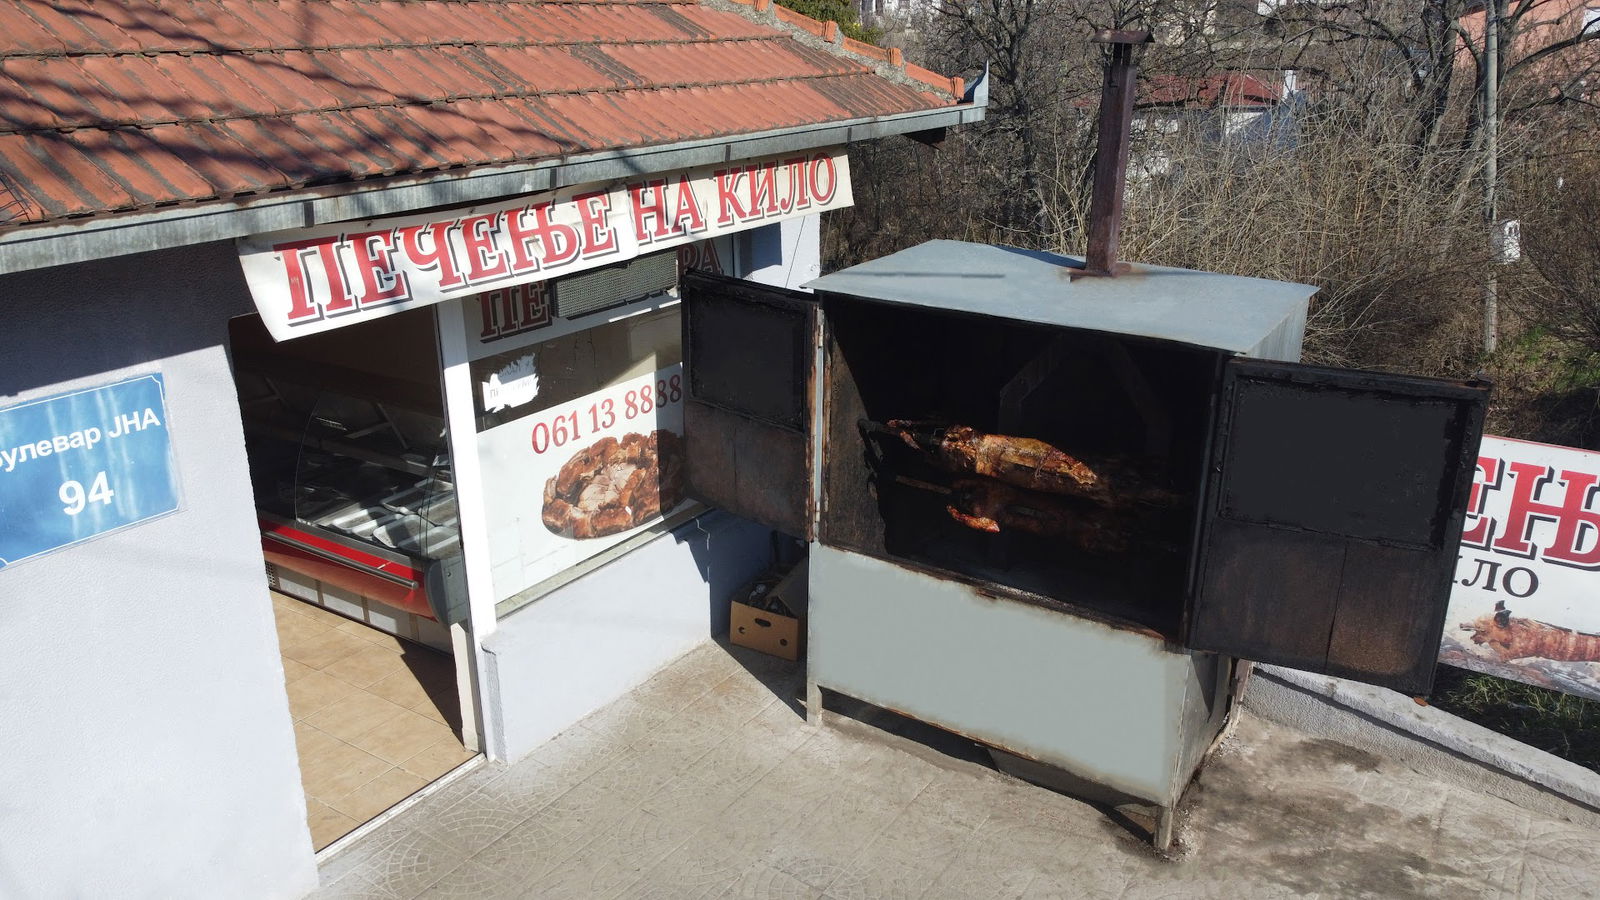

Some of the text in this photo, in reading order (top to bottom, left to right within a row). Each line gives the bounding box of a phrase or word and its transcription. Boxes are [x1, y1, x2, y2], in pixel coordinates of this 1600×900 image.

[274, 153, 838, 327] ПЕЧЕЊЕ НА КИЛО
[108, 407, 161, 438] ЈНА
[531, 410, 581, 455] 061
[588, 398, 616, 434] 13
[58, 471, 114, 515] 94
[1452, 555, 1539, 598] ЛО
